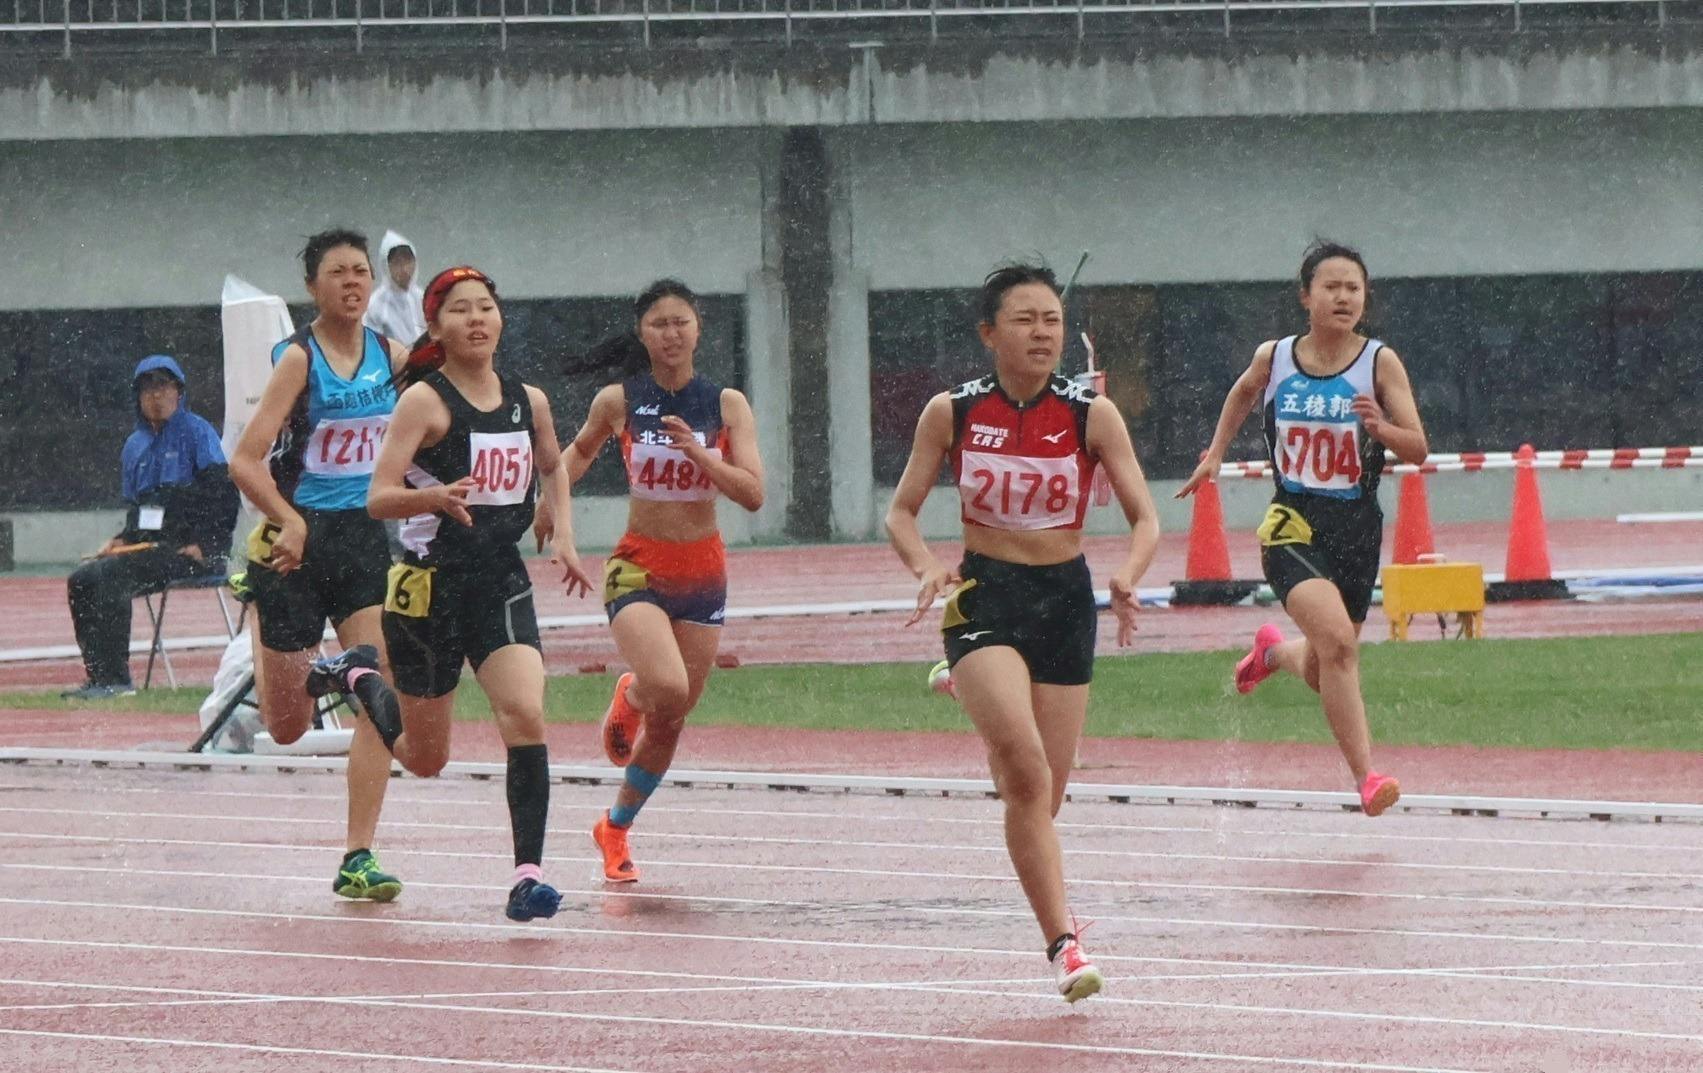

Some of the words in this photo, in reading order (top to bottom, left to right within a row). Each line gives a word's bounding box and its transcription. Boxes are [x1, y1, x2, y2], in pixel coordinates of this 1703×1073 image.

[472, 447, 531, 494] 4051
[971, 469, 1070, 515] 2178
[1271, 507, 1292, 541] 2
[395, 568, 413, 610] 6
